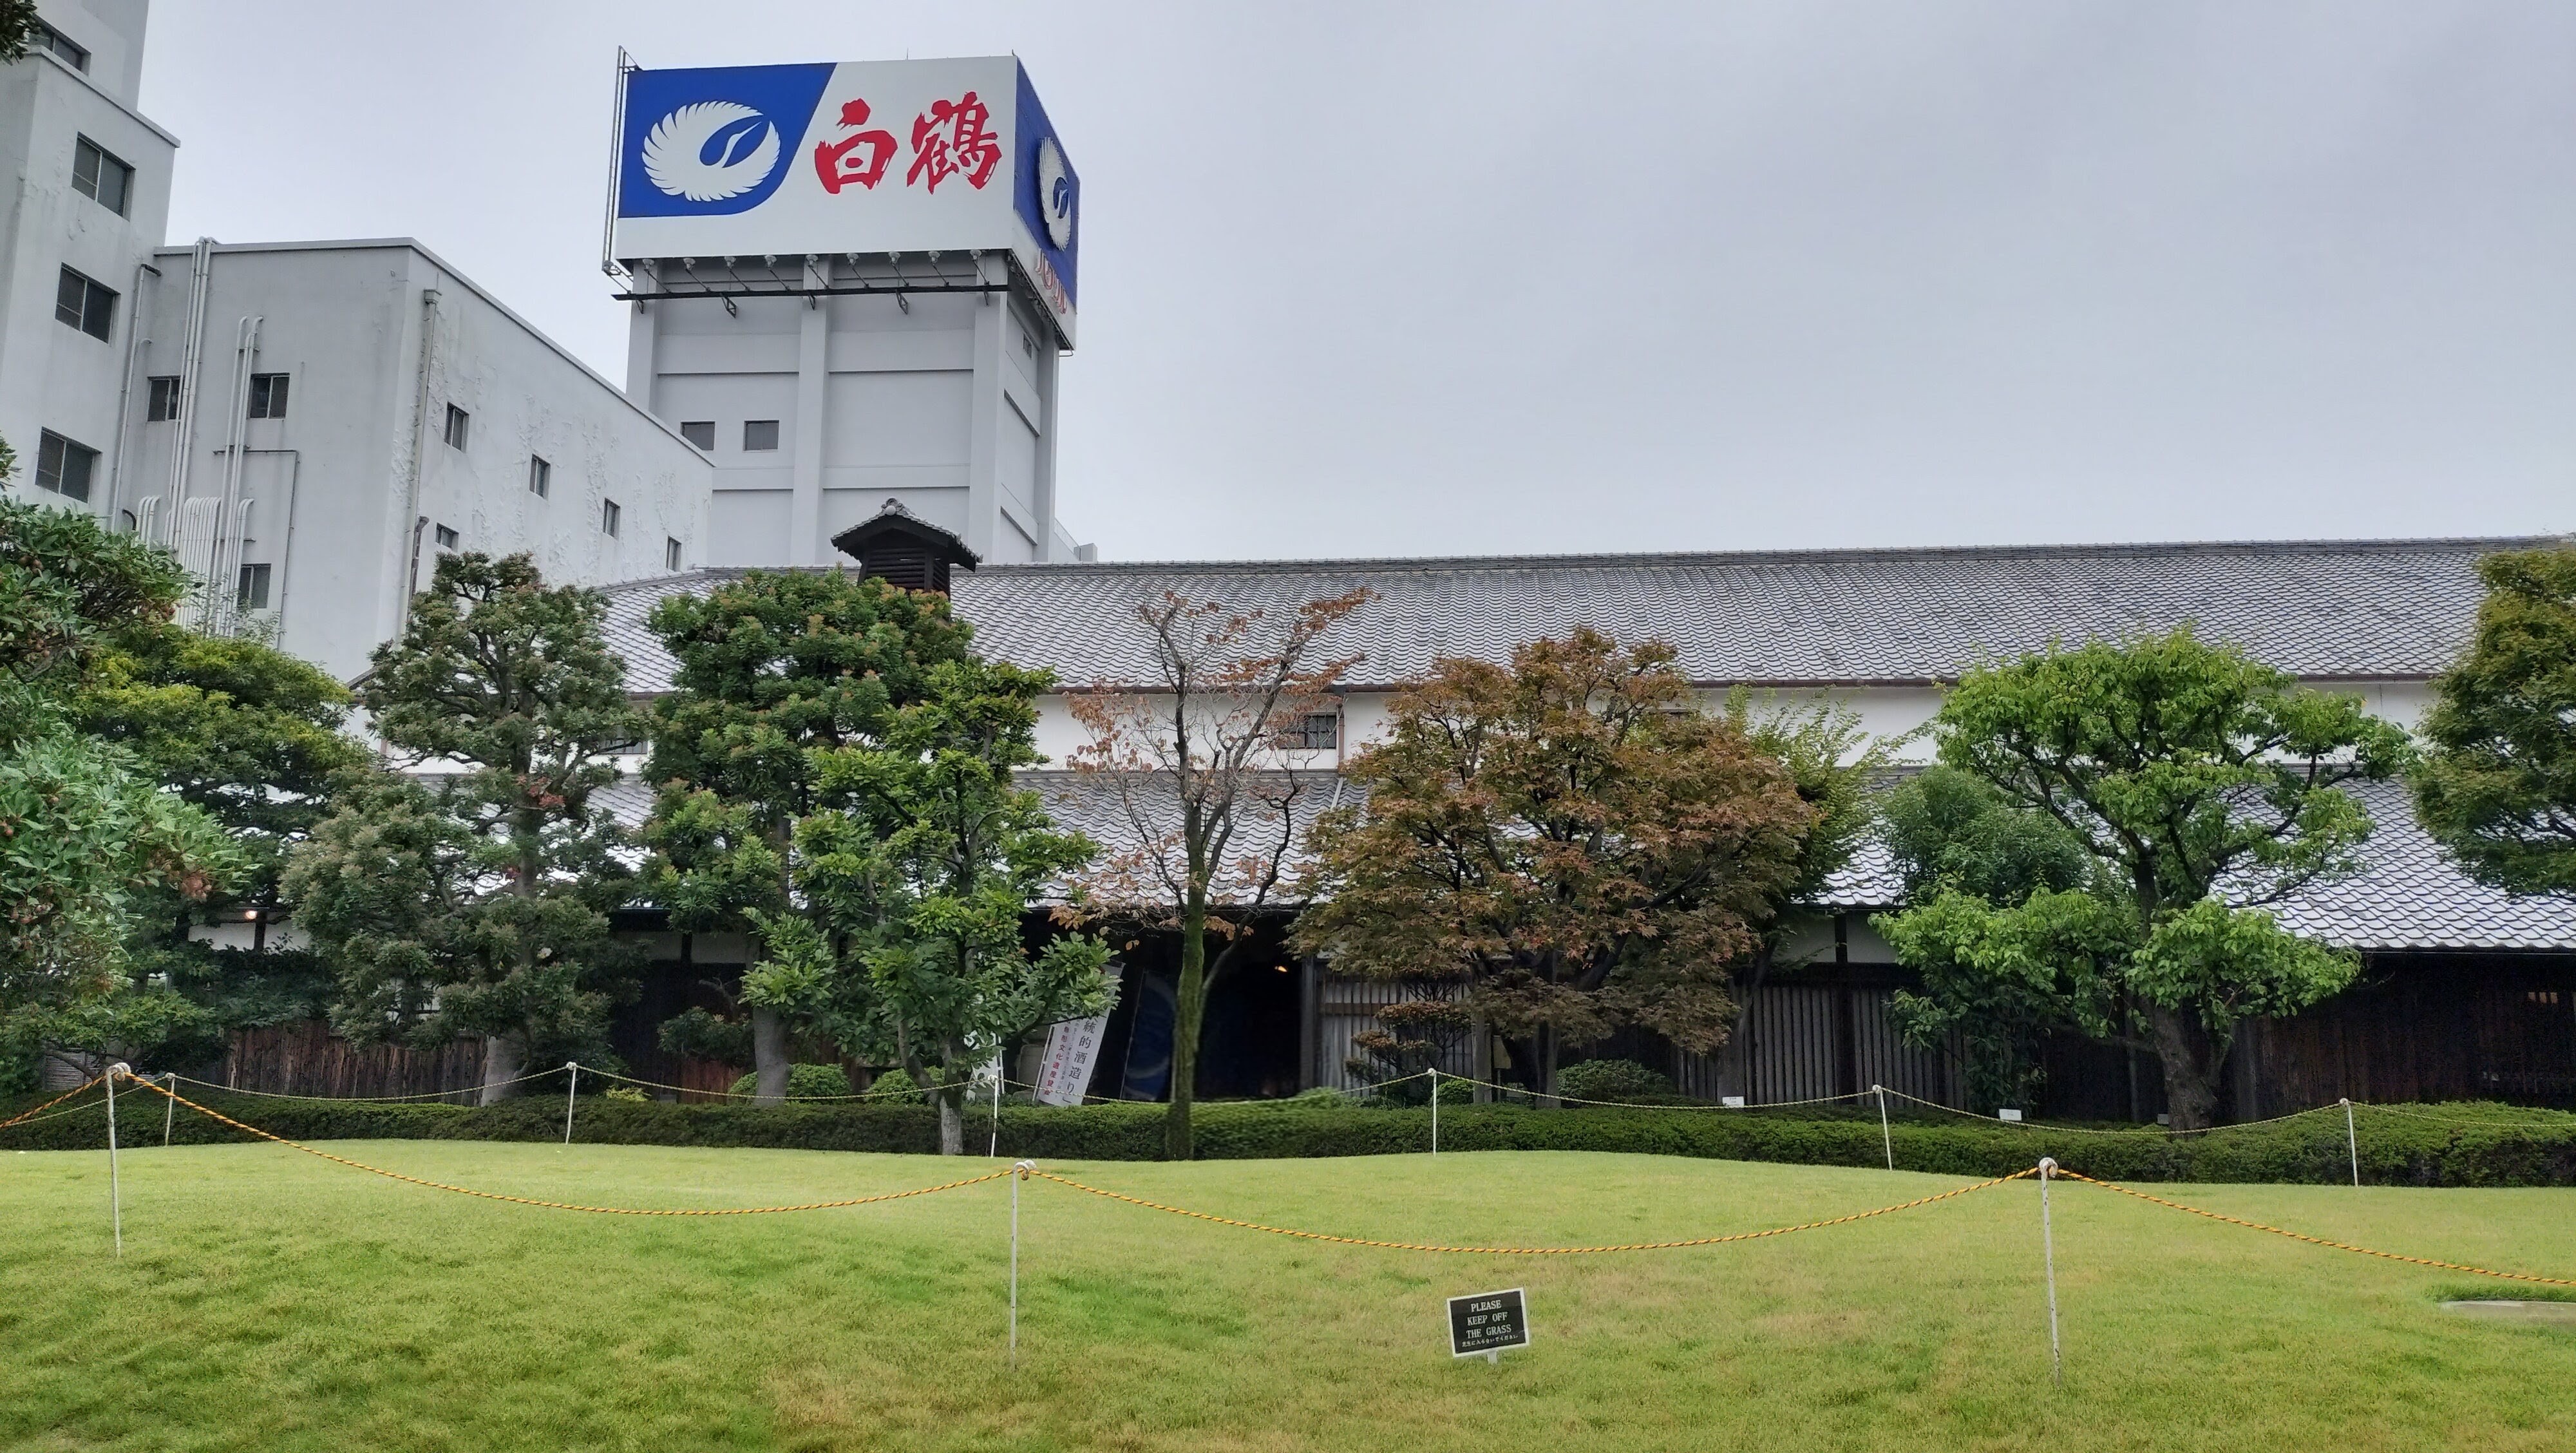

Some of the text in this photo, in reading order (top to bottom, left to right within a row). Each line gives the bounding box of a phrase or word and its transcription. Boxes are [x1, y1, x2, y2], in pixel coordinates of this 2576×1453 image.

[815, 91, 1001, 195] 白鶴
[1062, 1018, 1099, 1103] 統的酒造り」
[1471, 1300, 1502, 1313] PLEASE
[1467, 1311, 1508, 1326] KEEP OFF
[1466, 1324, 1512, 1339] THE GRASS
